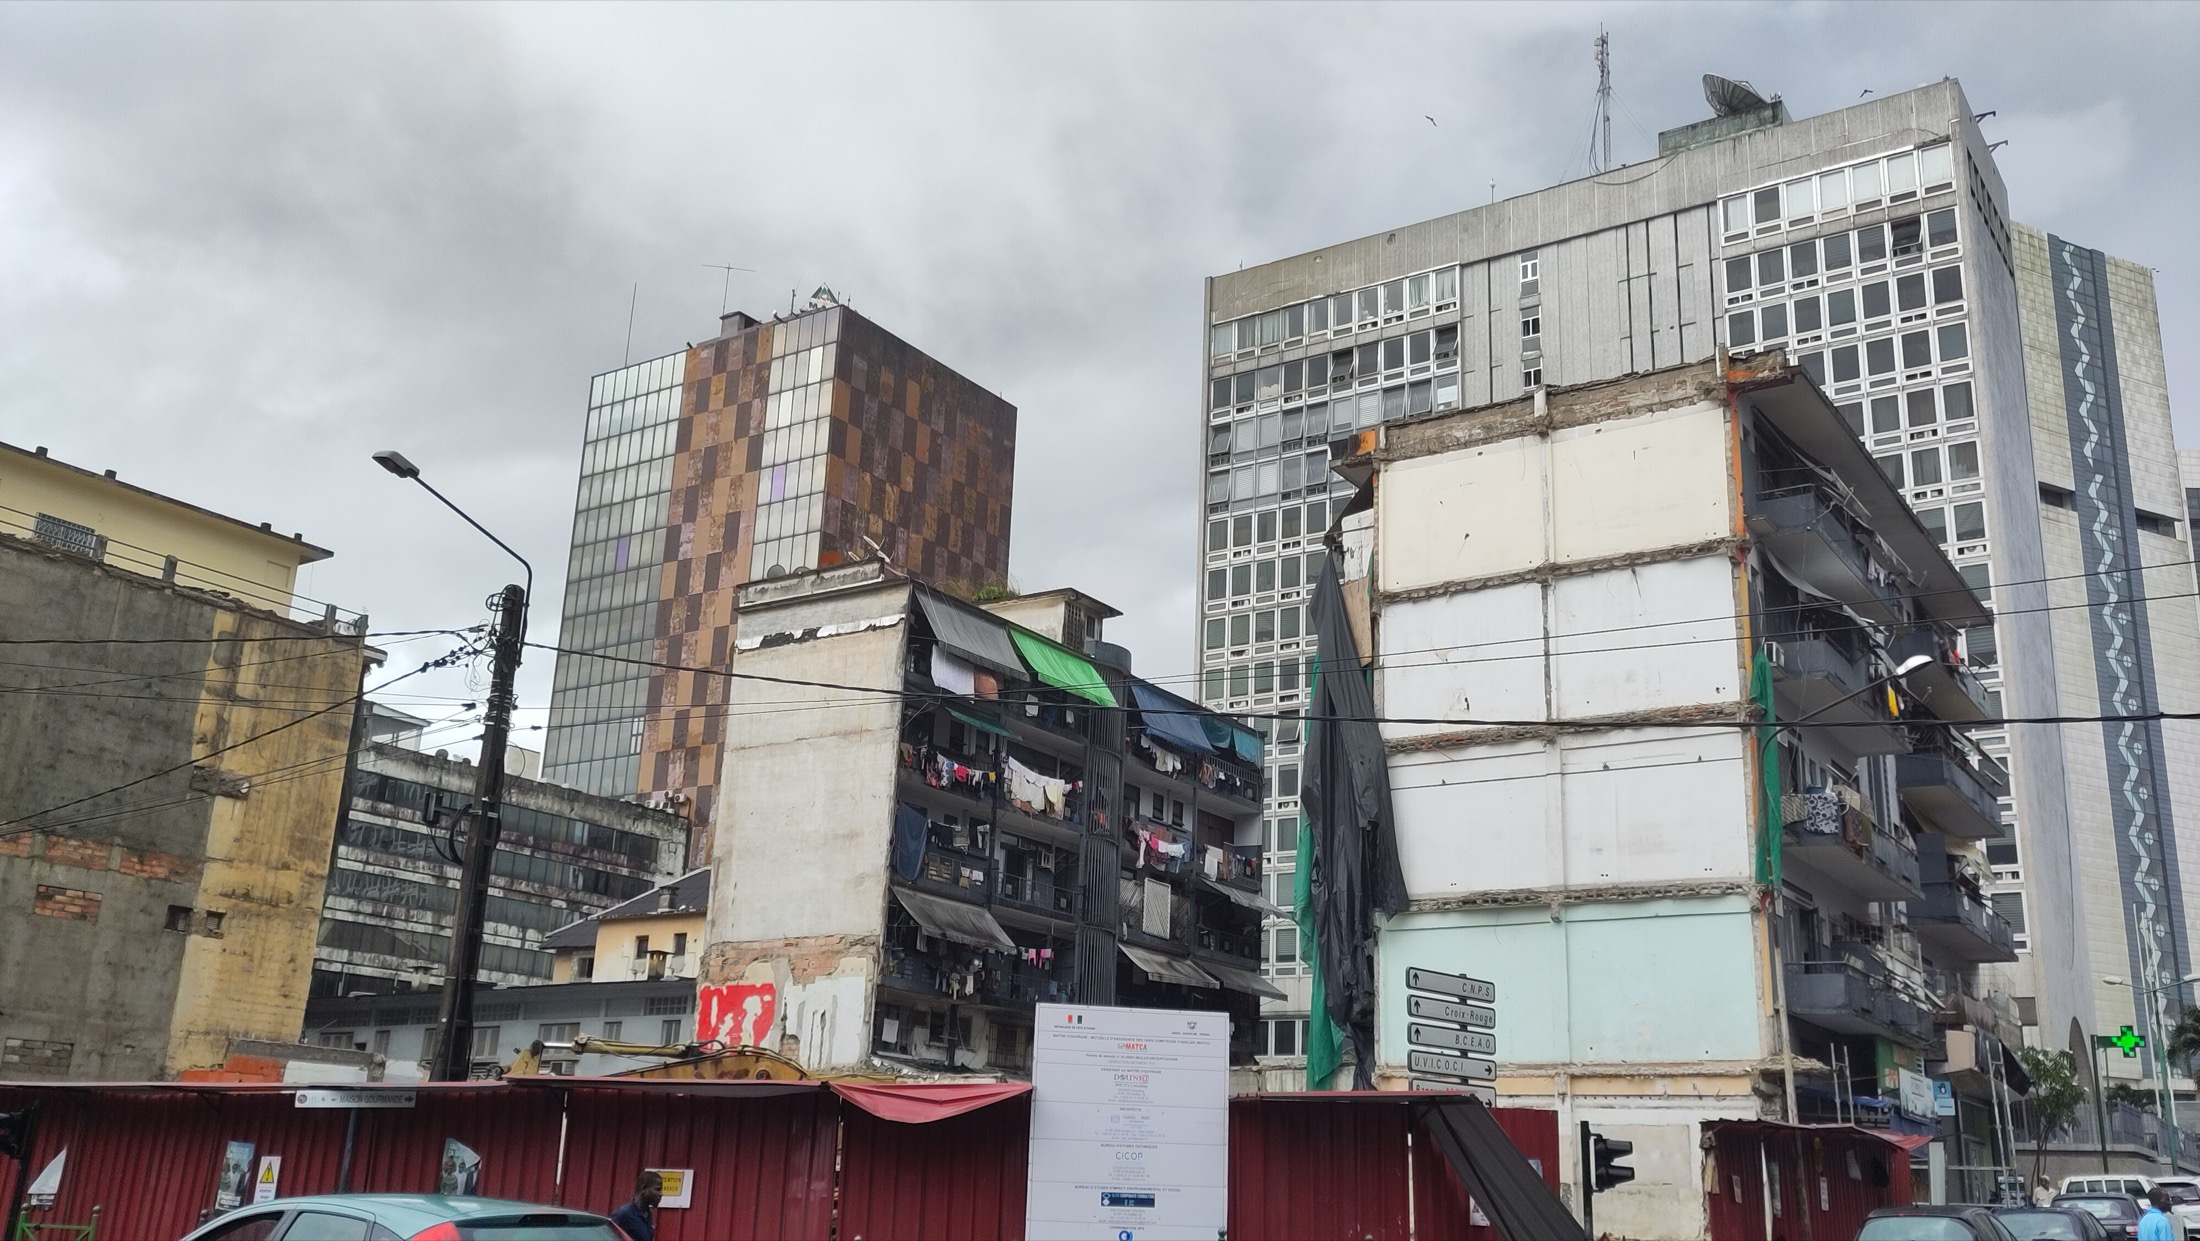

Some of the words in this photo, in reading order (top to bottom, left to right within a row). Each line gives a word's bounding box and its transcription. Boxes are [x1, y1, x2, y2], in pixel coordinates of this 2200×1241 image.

[1462, 983, 1492, 998] C.N.P.S.
[1444, 1006, 1493, 1026] Croix-Rouge
[1124, 1043, 1148, 1051] MATCA
[1455, 1034, 1493, 1050] B.C.E.A.O.
[1414, 1056, 1465, 1073] U.V.I.C.O.C.I.
[339, 1095, 363, 1104] MAISON
[364, 1095, 404, 1104] GOURMANDE
[1115, 1151, 1143, 1160] CICOP
